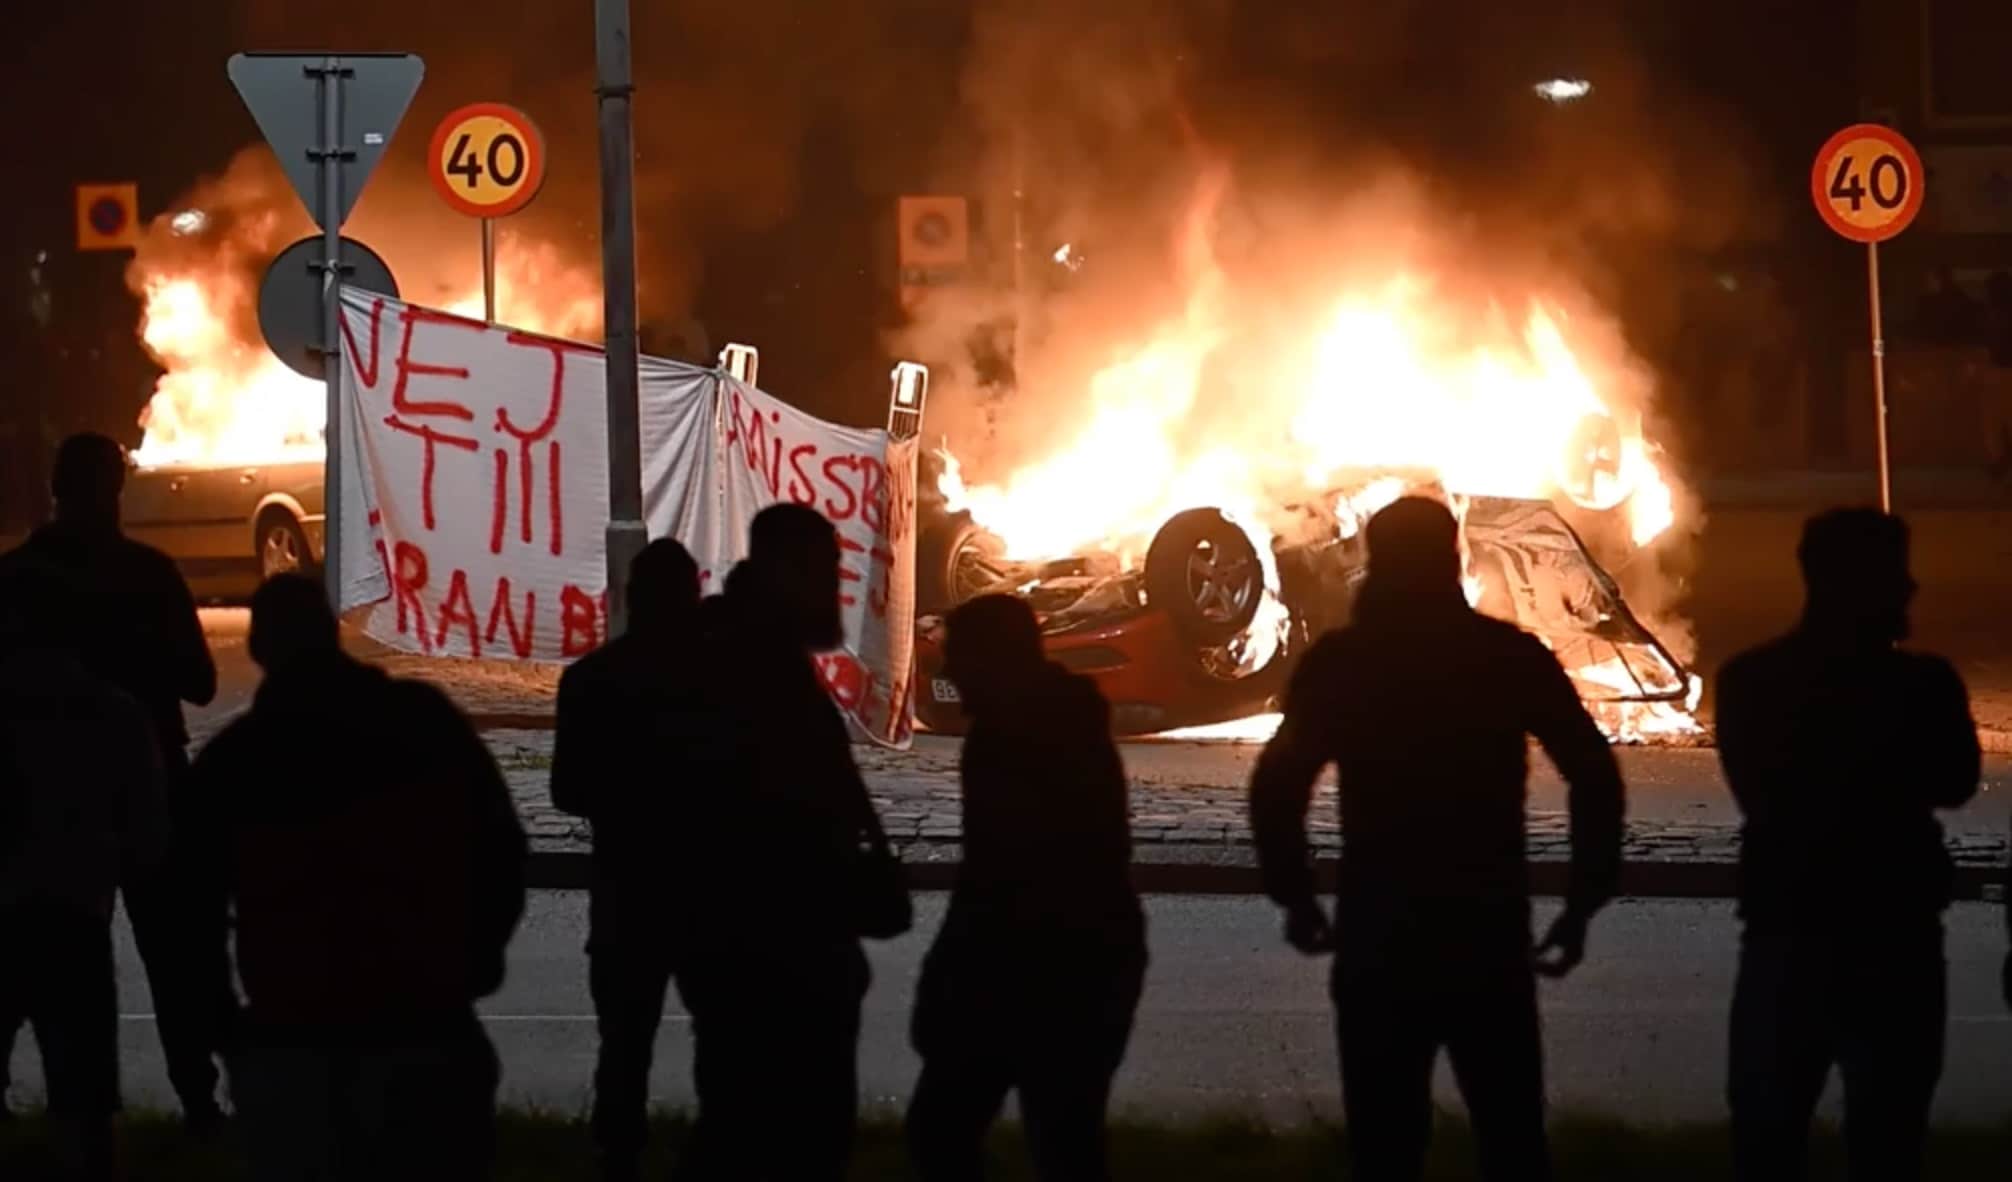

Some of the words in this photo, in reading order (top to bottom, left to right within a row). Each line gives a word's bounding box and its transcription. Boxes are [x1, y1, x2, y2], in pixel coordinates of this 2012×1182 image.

[447, 134, 524, 188] 40
[1830, 154, 1907, 211] 40
[338, 299, 606, 441] NEJ
